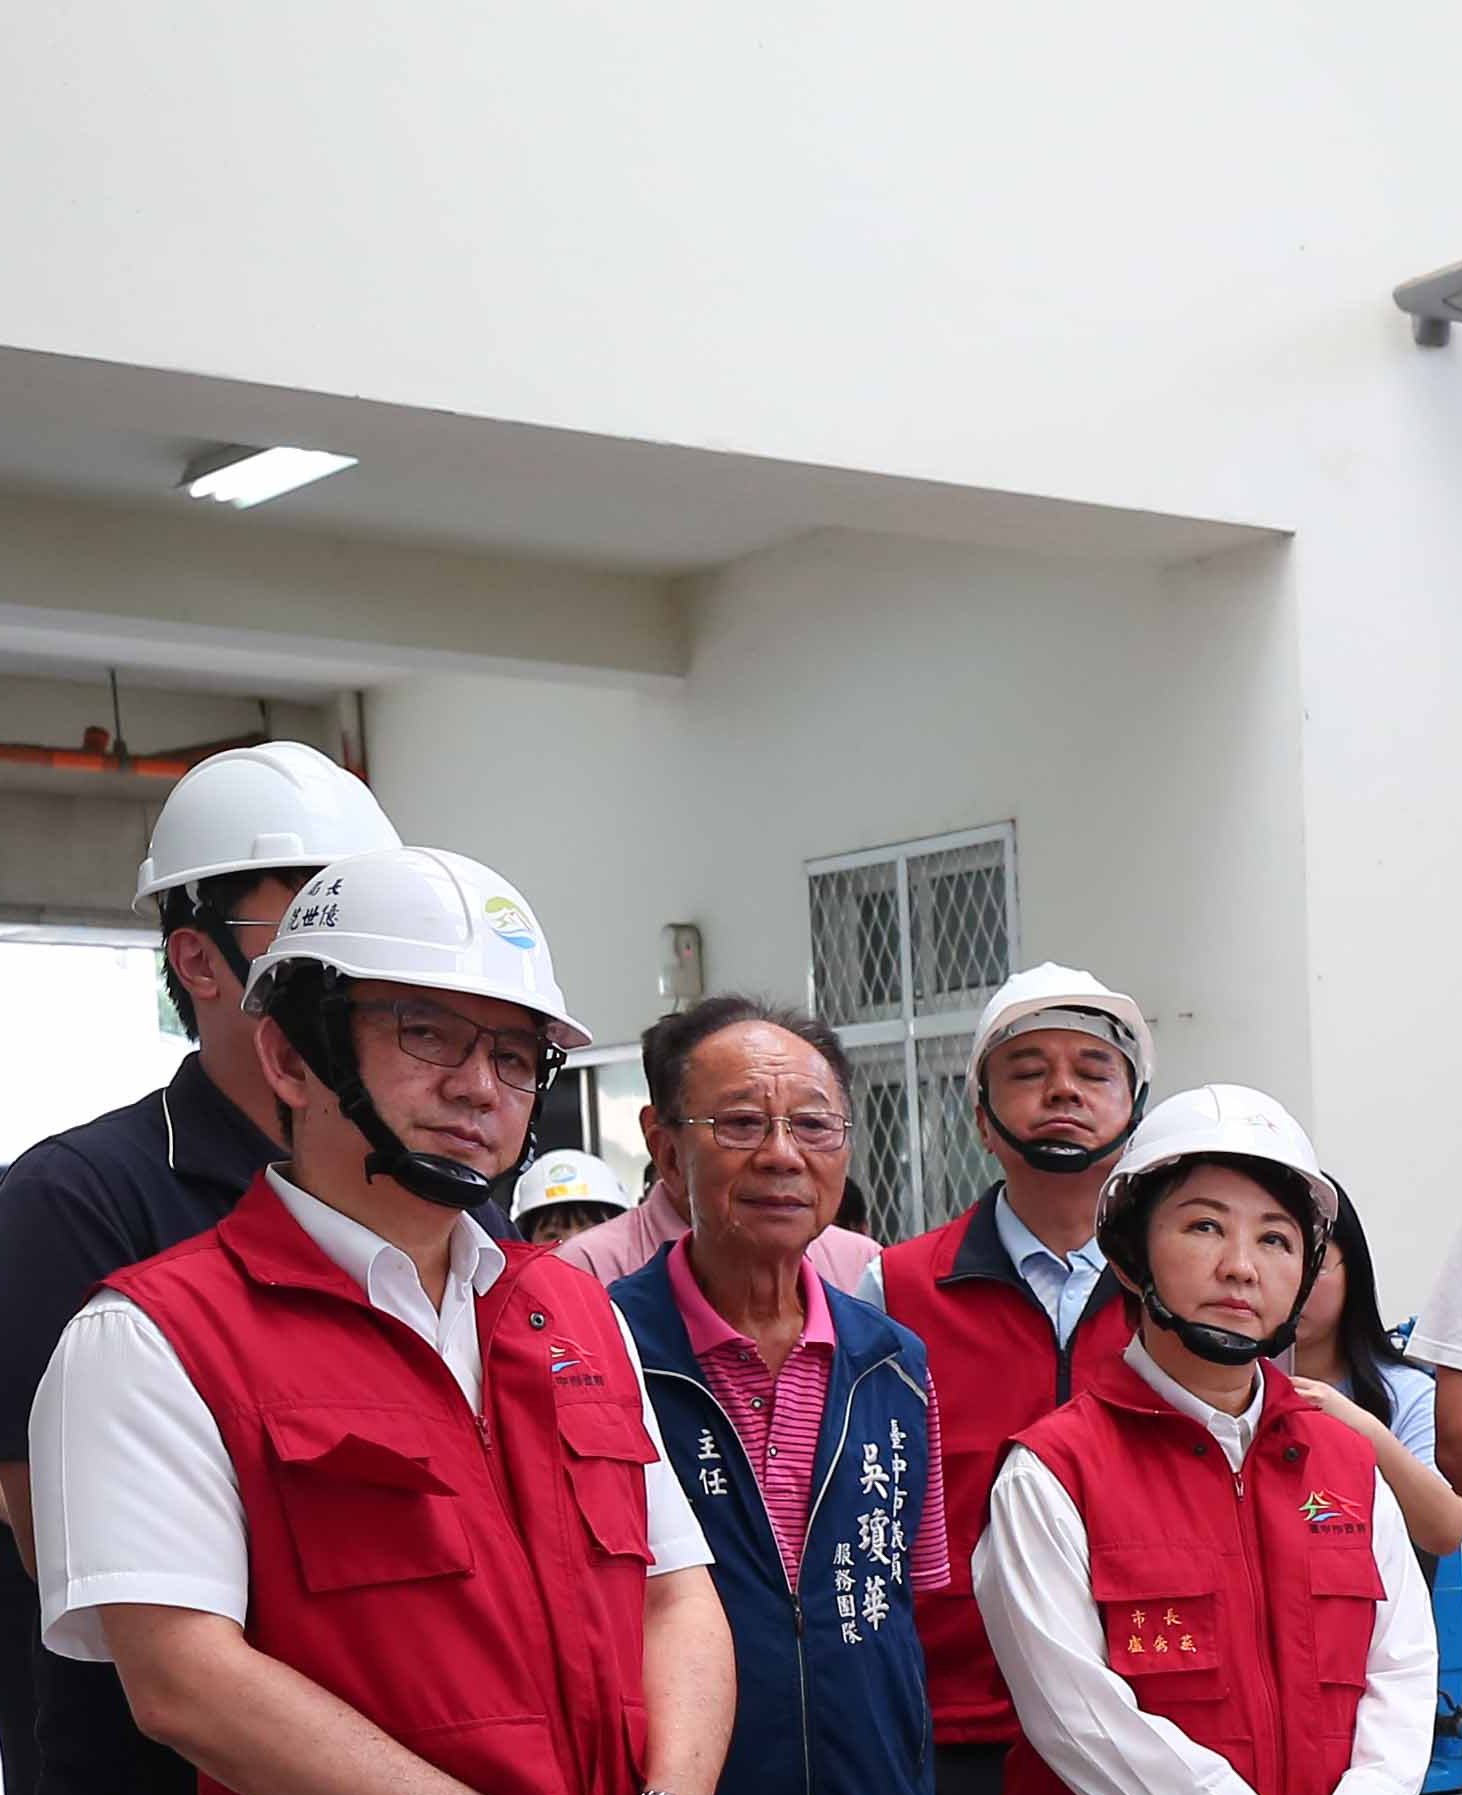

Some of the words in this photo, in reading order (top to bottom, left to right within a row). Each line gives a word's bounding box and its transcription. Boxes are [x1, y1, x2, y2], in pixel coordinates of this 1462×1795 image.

[697, 1428, 728, 1496] 主任
[857, 1443, 891, 1631] 吳瓊華
[832, 1543, 863, 1644] 服務團隊
[1131, 1607, 1183, 1630] 市長
